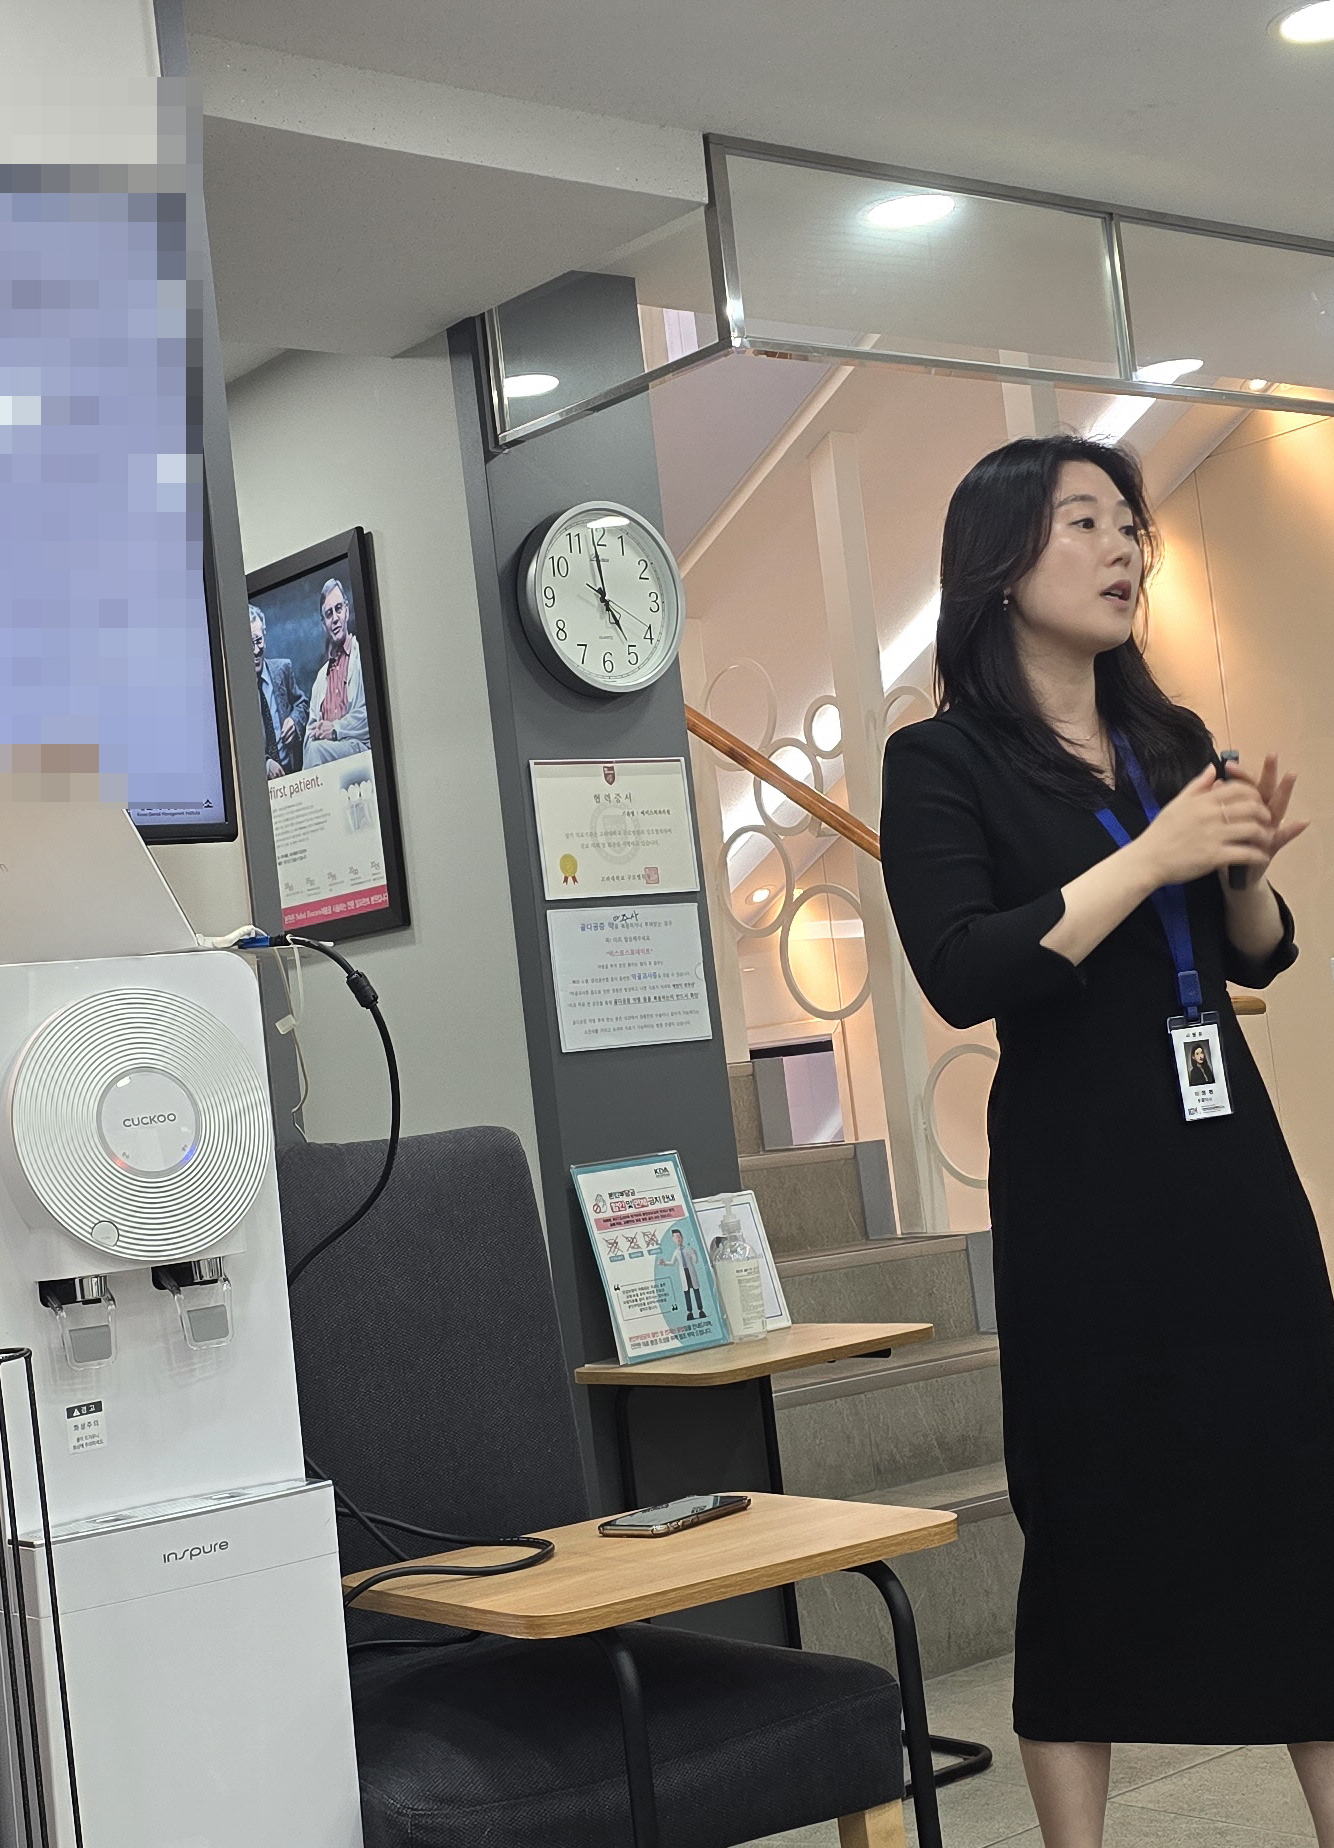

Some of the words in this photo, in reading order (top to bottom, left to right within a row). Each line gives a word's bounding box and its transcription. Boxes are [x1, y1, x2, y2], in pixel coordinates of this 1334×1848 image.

[566, 533, 581, 554] 11
[618, 536, 625, 556] 1
[549, 556, 569, 577] 10
[637, 559, 649, 580] 2
[544, 586, 555, 608] 9
[648, 592, 660, 613] 3
[556, 619, 567, 641] 8
[643, 624, 654, 645] 4
[576, 644, 588, 665] 7
[602, 652, 614, 673] 6
[627, 644, 639, 665] 5
[269, 784, 287, 800] first
[289, 775, 324, 798] patient.
[122, 1113, 176, 1128] CUCKOO
[162, 1540, 229, 1564] inspure
